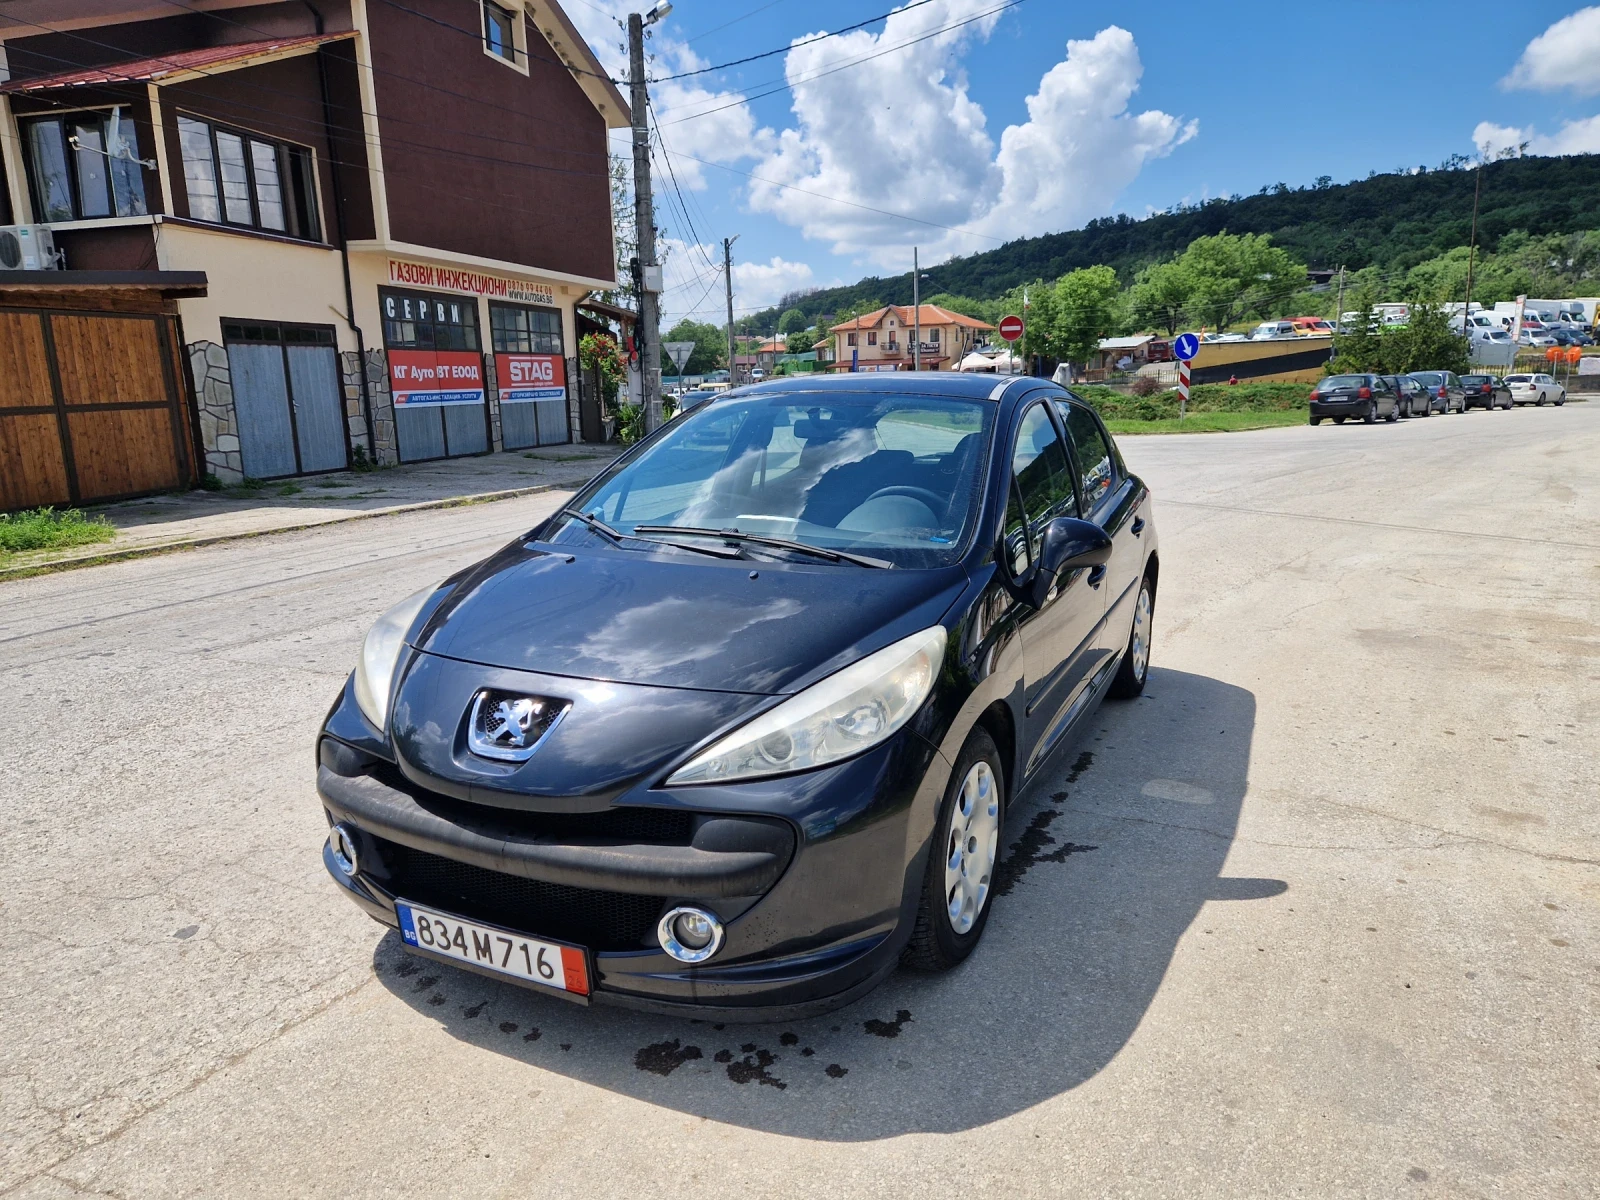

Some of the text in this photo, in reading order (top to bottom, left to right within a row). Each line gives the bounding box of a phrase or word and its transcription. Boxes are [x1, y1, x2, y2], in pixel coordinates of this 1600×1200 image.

[389, 260, 507, 297] ГАЗОВИ ИНЖЕКЦИОНИ
[507, 279, 524, 291] 0876
[525, 283, 534, 292] 99
[535, 284, 543, 294] 44
[507, 289, 553, 304] WWW.AUTOGAS.BG
[393, 365, 408, 379] КГ
[410, 365, 434, 382] Ауто
[452, 365, 479, 380] ЕООД
[509, 361, 553, 381] STAG
[404, 929, 416, 941] BG
[417, 915, 554, 979] 834M716
